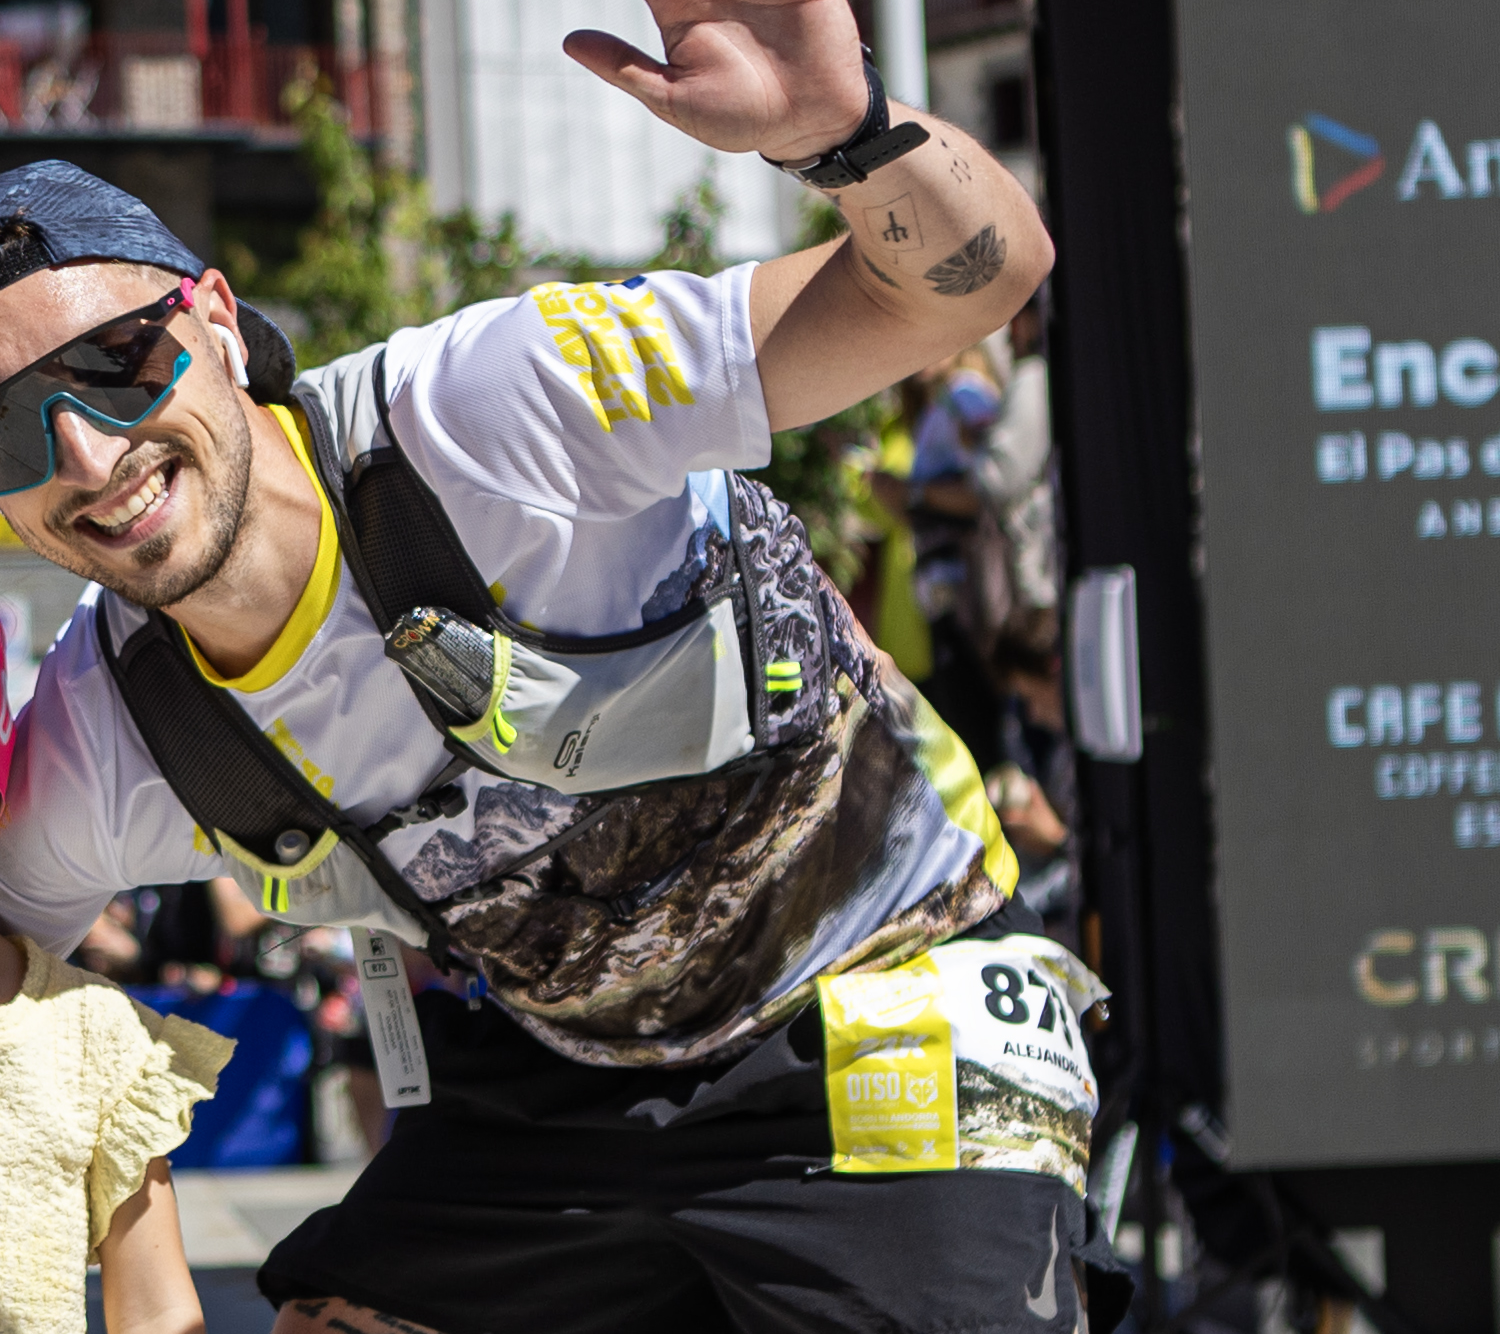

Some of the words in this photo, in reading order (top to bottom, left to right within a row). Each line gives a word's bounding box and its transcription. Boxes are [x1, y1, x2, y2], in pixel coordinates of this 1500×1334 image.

[609, 290, 696, 406] 21K
[1317, 432, 1366, 482] El
[1379, 433, 1468, 479] Pas
[1327, 683, 1482, 747] CAFE
[854, 1034, 929, 1059] 21K
[847, 1071, 901, 1101] OTSO
